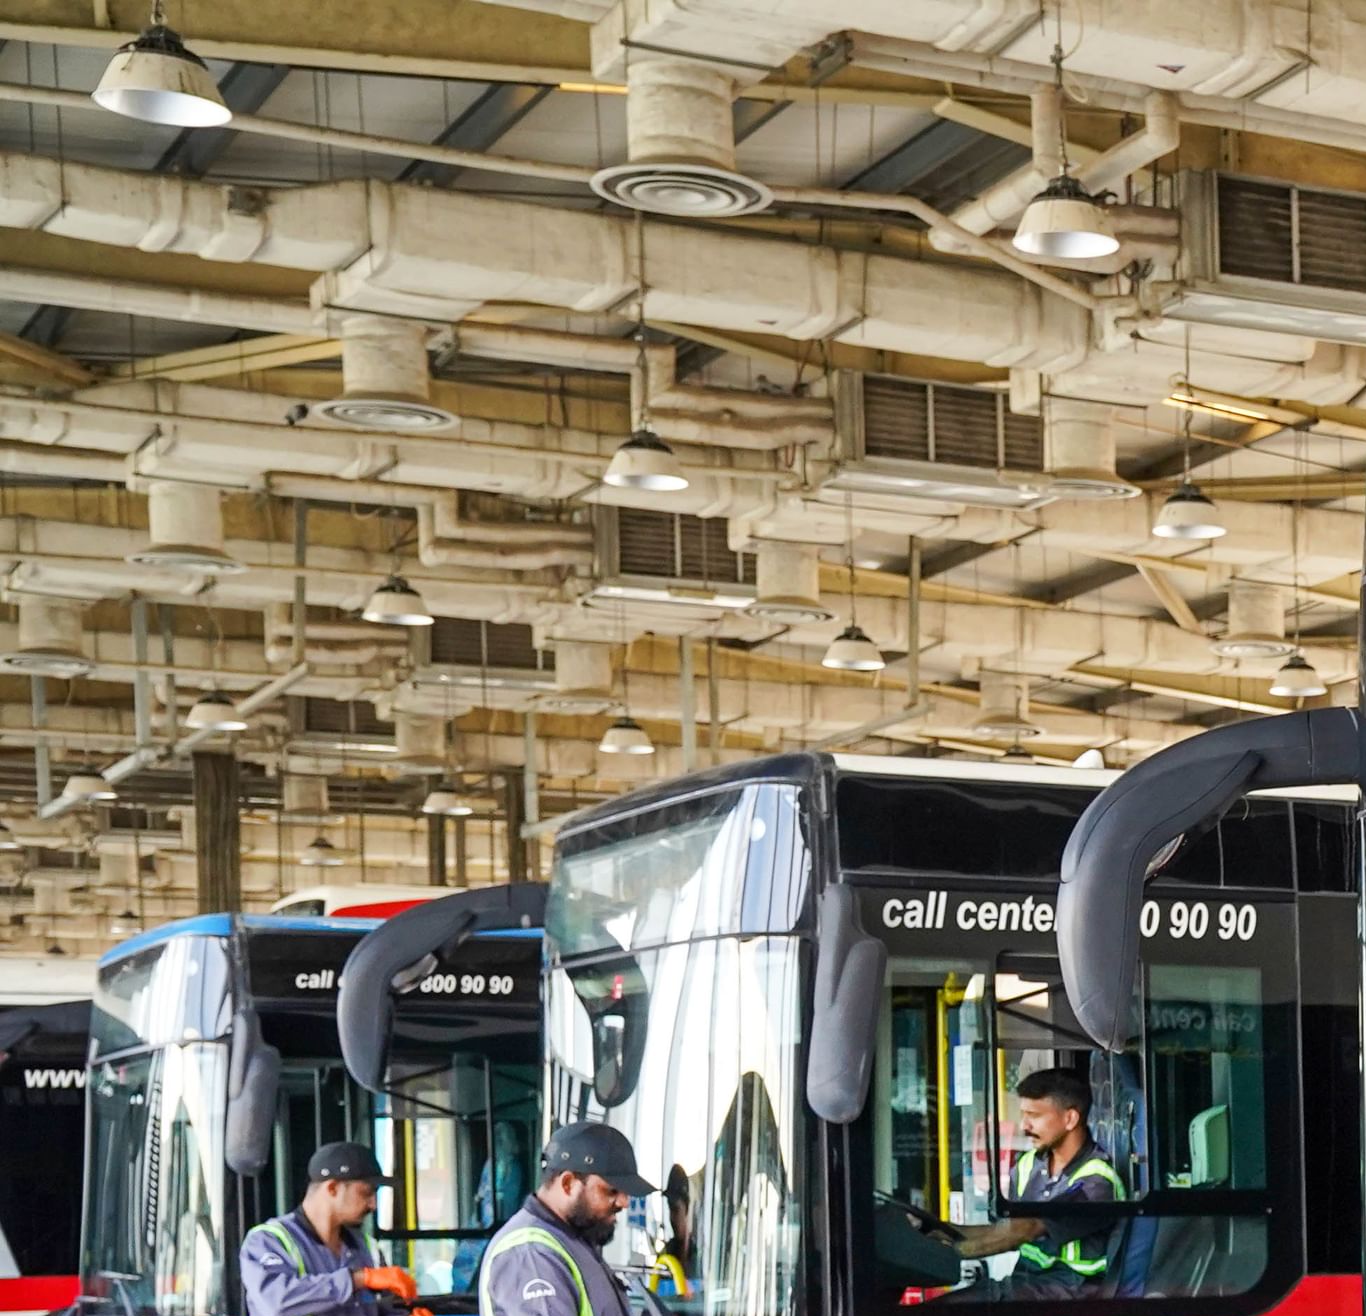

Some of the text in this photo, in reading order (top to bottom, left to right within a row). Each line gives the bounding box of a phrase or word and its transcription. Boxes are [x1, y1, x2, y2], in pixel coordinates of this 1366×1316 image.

[882, 891, 948, 930] call
[956, 895, 1058, 932] cente
[1169, 902, 1209, 940] 90
[1218, 904, 1258, 941] 90
[295, 969, 334, 989] call
[460, 975, 485, 994] 90
[488, 976, 513, 995] 90
